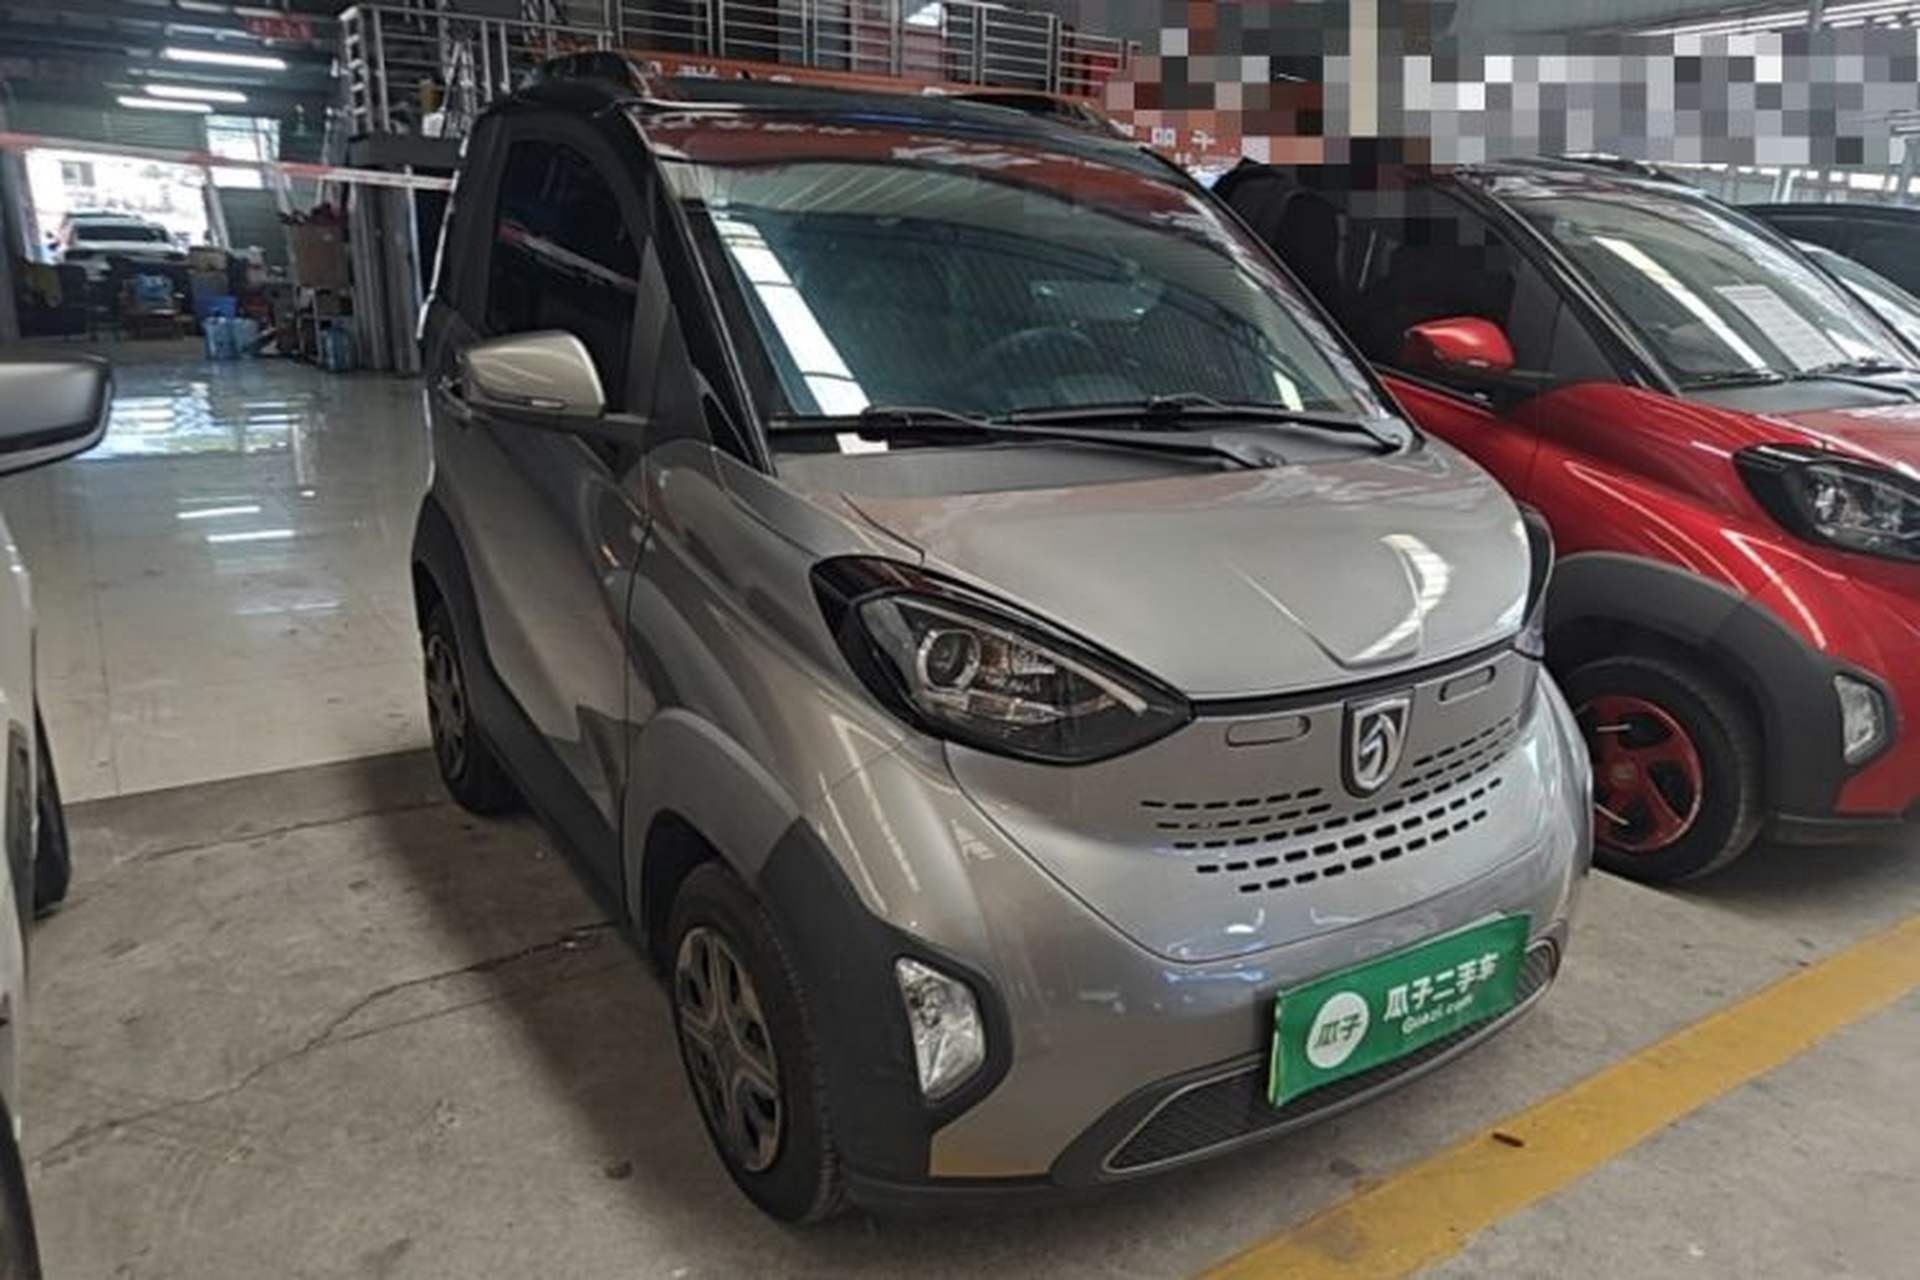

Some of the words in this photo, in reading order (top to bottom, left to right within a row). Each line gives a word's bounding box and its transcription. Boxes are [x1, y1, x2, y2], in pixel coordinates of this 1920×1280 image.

[1384, 952, 1499, 1022] 瓜子二手车
[1314, 1013, 1363, 1048] 瓜子
